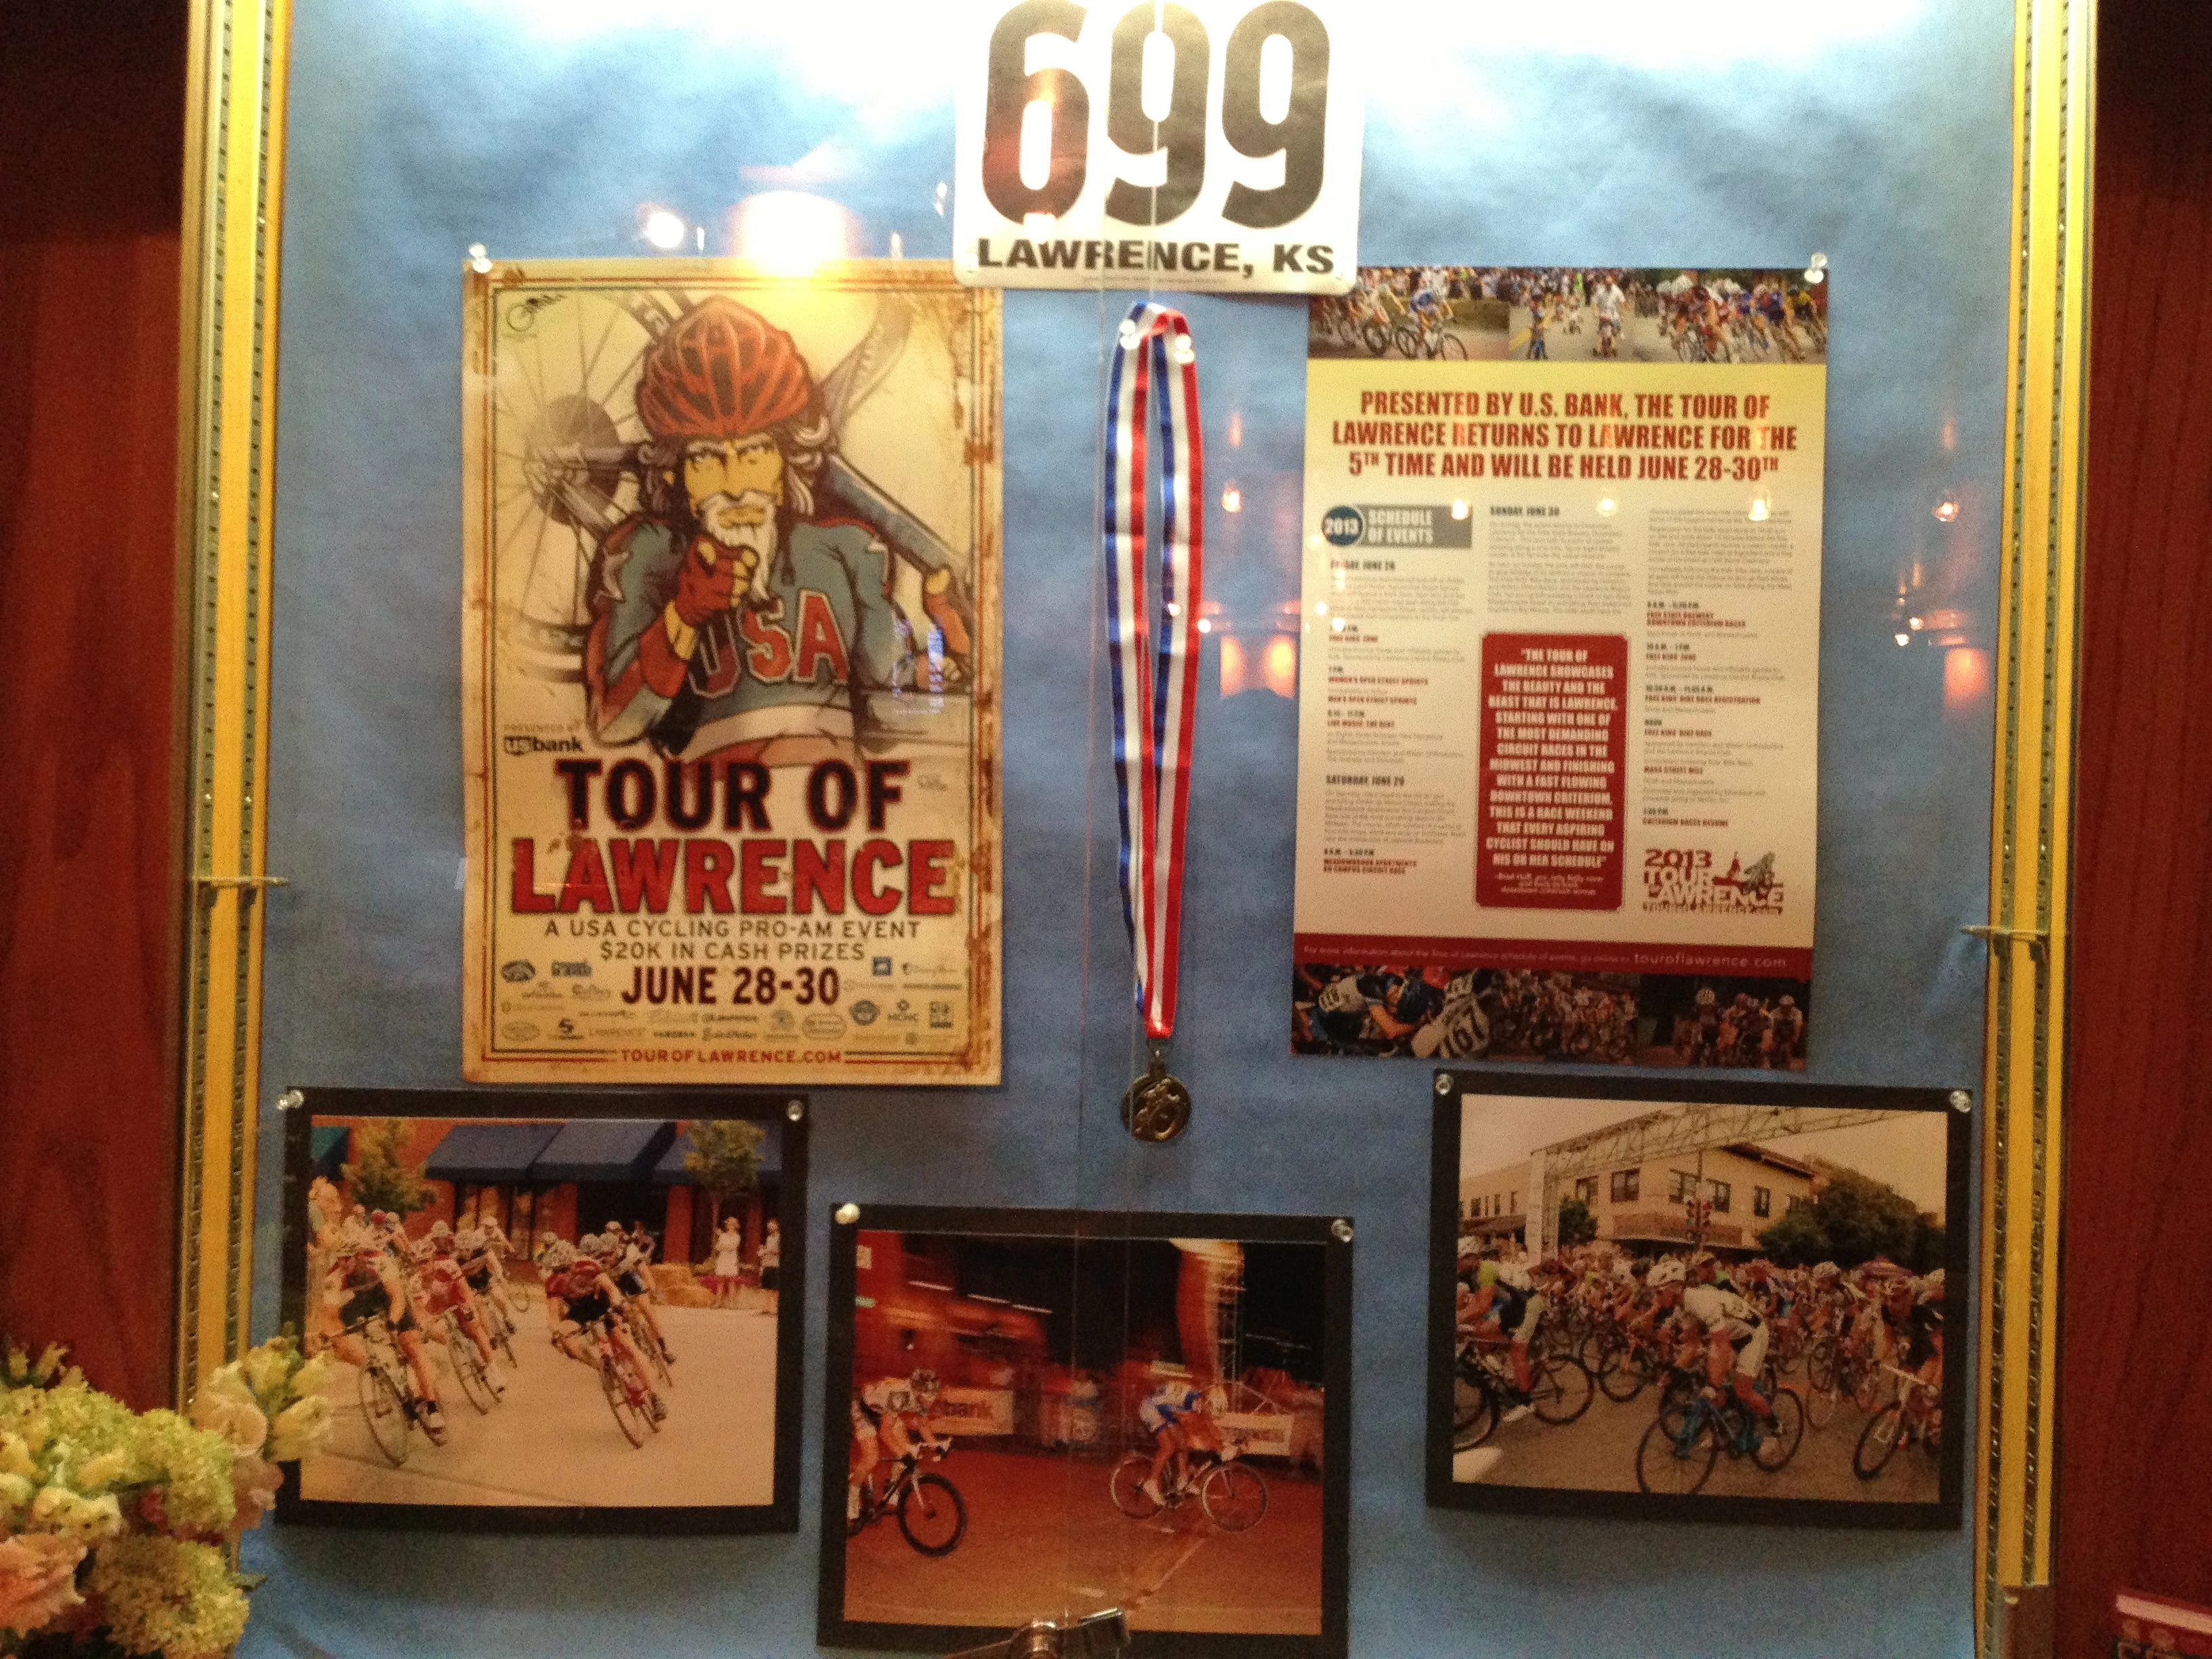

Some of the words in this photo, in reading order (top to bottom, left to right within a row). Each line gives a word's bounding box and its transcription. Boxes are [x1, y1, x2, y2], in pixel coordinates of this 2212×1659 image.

[982, 0, 1330, 230] 699
[978, 239, 1255, 279] LAWRENCE,
[1273, 243, 1334, 274] KS
[1361, 392, 1479, 416] PRESENTED
[1486, 392, 1512, 417] BY
[1519, 393, 1557, 417] U.S.
[1635, 394, 1673, 419] THE
[1680, 394, 1736, 419] TOUR
[1744, 395, 1769, 419] OF
[1332, 421, 1446, 447] LAWRENCE
[1452, 422, 1550, 448] RETURNS
[1557, 424, 1581, 448] TO
[1589, 424, 1703, 449] LAWRENCE
[1711, 426, 1750, 449] FOR
[1757, 426, 1797, 450] THE
[1385, 453, 1435, 476] TIME
[1441, 453, 1485, 478] AND
[1492, 454, 1541, 478] WILL
[1548, 455, 1573, 478] BE
[1580, 455, 1632, 479] HELD
[1638, 455, 1688, 480] JUNE
[1368, 510, 1433, 526] SCHEDULE
[1325, 518, 1359, 535] 2013
[1386, 527, 1434, 544] EVENTS
[687, 586, 849, 699] USA
[1546, 649, 1574, 662] TOUR
[1575, 649, 1588, 663] OF
[1494, 663, 1549, 677] LAWRENCE
[1502, 680, 1521, 692] THE
[1523, 680, 1562, 693] BEAUTY
[1563, 681, 1585, 694] AND
[1586, 681, 1605, 695] THE
[1488, 695, 1521, 708] BEAST
[1522, 696, 1548, 709] THAT
[1549, 697, 1560, 710] IS
[1495, 711, 1545, 725] STARTING
[1546, 712, 1575, 725] WITH
[1576, 713, 1596, 726] ONE
[1597, 713, 1611, 726] OF
[1497, 726, 1515, 740] THE
[1517, 727, 1547, 741] MOST
[1548, 728, 1609, 742] DEMANDING
[1496, 742, 1538, 756] CIRCUIT
[1575, 744, 1587, 757] IN
[1589, 745, 1608, 758] THE
[1490, 758, 1538, 772] MIDWEST
[1540, 759, 1561, 773] AND
[1563, 760, 1616, 773] FINISHING
[1496, 774, 1525, 787] WITH
[1534, 775, 1559, 788] FAST
[1561, 775, 1607, 790] FLOWING
[555, 758, 774, 833] TOUR
[806, 759, 911, 833] OF
[1490, 790, 1553, 803] DOWNTOWN
[1490, 805, 1513, 819] THIS
[1515, 806, 1526, 819] IS
[1564, 807, 1614, 821] WEEKEND
[1496, 821, 1521, 834] THAT
[1523, 821, 1555, 835] EVERY
[1486, 836, 1528, 850] CYCLIST
[1530, 838, 1570, 851] SHOULD
[1572, 839, 1598, 852] HAVE
[1599, 840, 1615, 853] ON
[1492, 853, 1511, 866] HIS
[1512, 853, 1528, 866] OR
[1645, 848, 1713, 867] 2013
[511, 837, 956, 916] LAWRENCE
[545, 919, 560, 937] A
[569, 919, 617, 937] USA
[625, 920, 731, 939] CYCLING
[739, 920, 834, 939] PRO-AM
[842, 920, 922, 939] EVENT
[600, 941, 661, 962] $20K
[671, 942, 695, 960] IN
[706, 942, 769, 961] CASH
[778, 942, 865, 962] PRIZES
[621, 966, 717, 1005] JUNE
[733, 966, 840, 1006] 28-30
[620, 1048, 842, 1064] TOUROFLAWRENCE.COM
